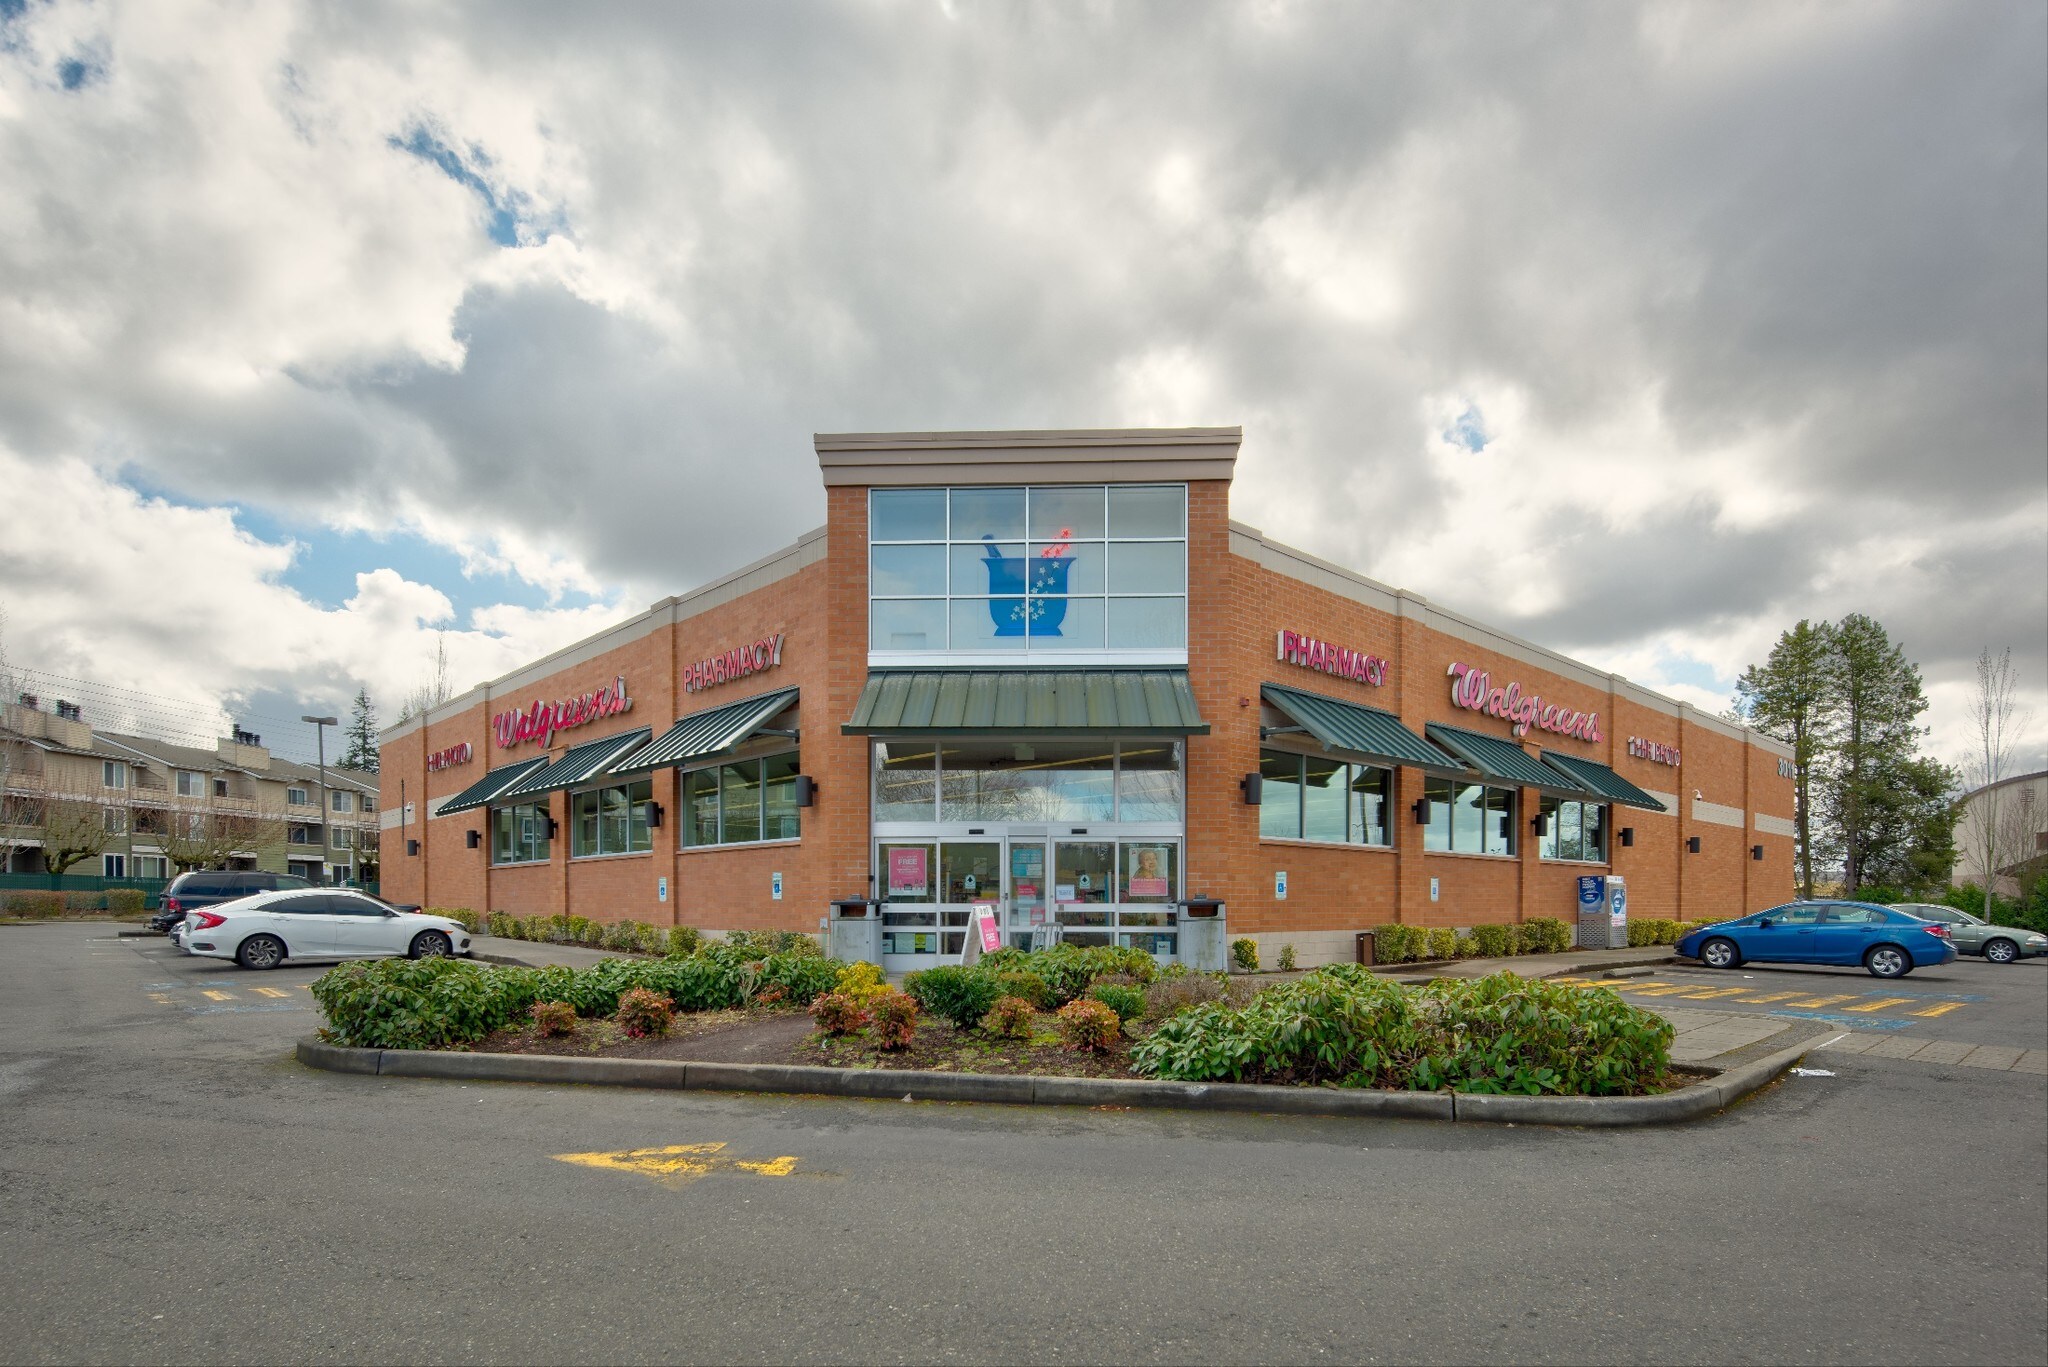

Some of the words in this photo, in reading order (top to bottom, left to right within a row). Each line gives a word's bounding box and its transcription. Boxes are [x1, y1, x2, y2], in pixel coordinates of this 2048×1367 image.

[682, 633, 785, 694] PHARMACY
[1277, 629, 1389, 687] PHARMACY
[492, 675, 632, 750] Walgreens
[1446, 661, 1604, 743] Walgreens
[1650, 741, 1680, 767] PHOTO
